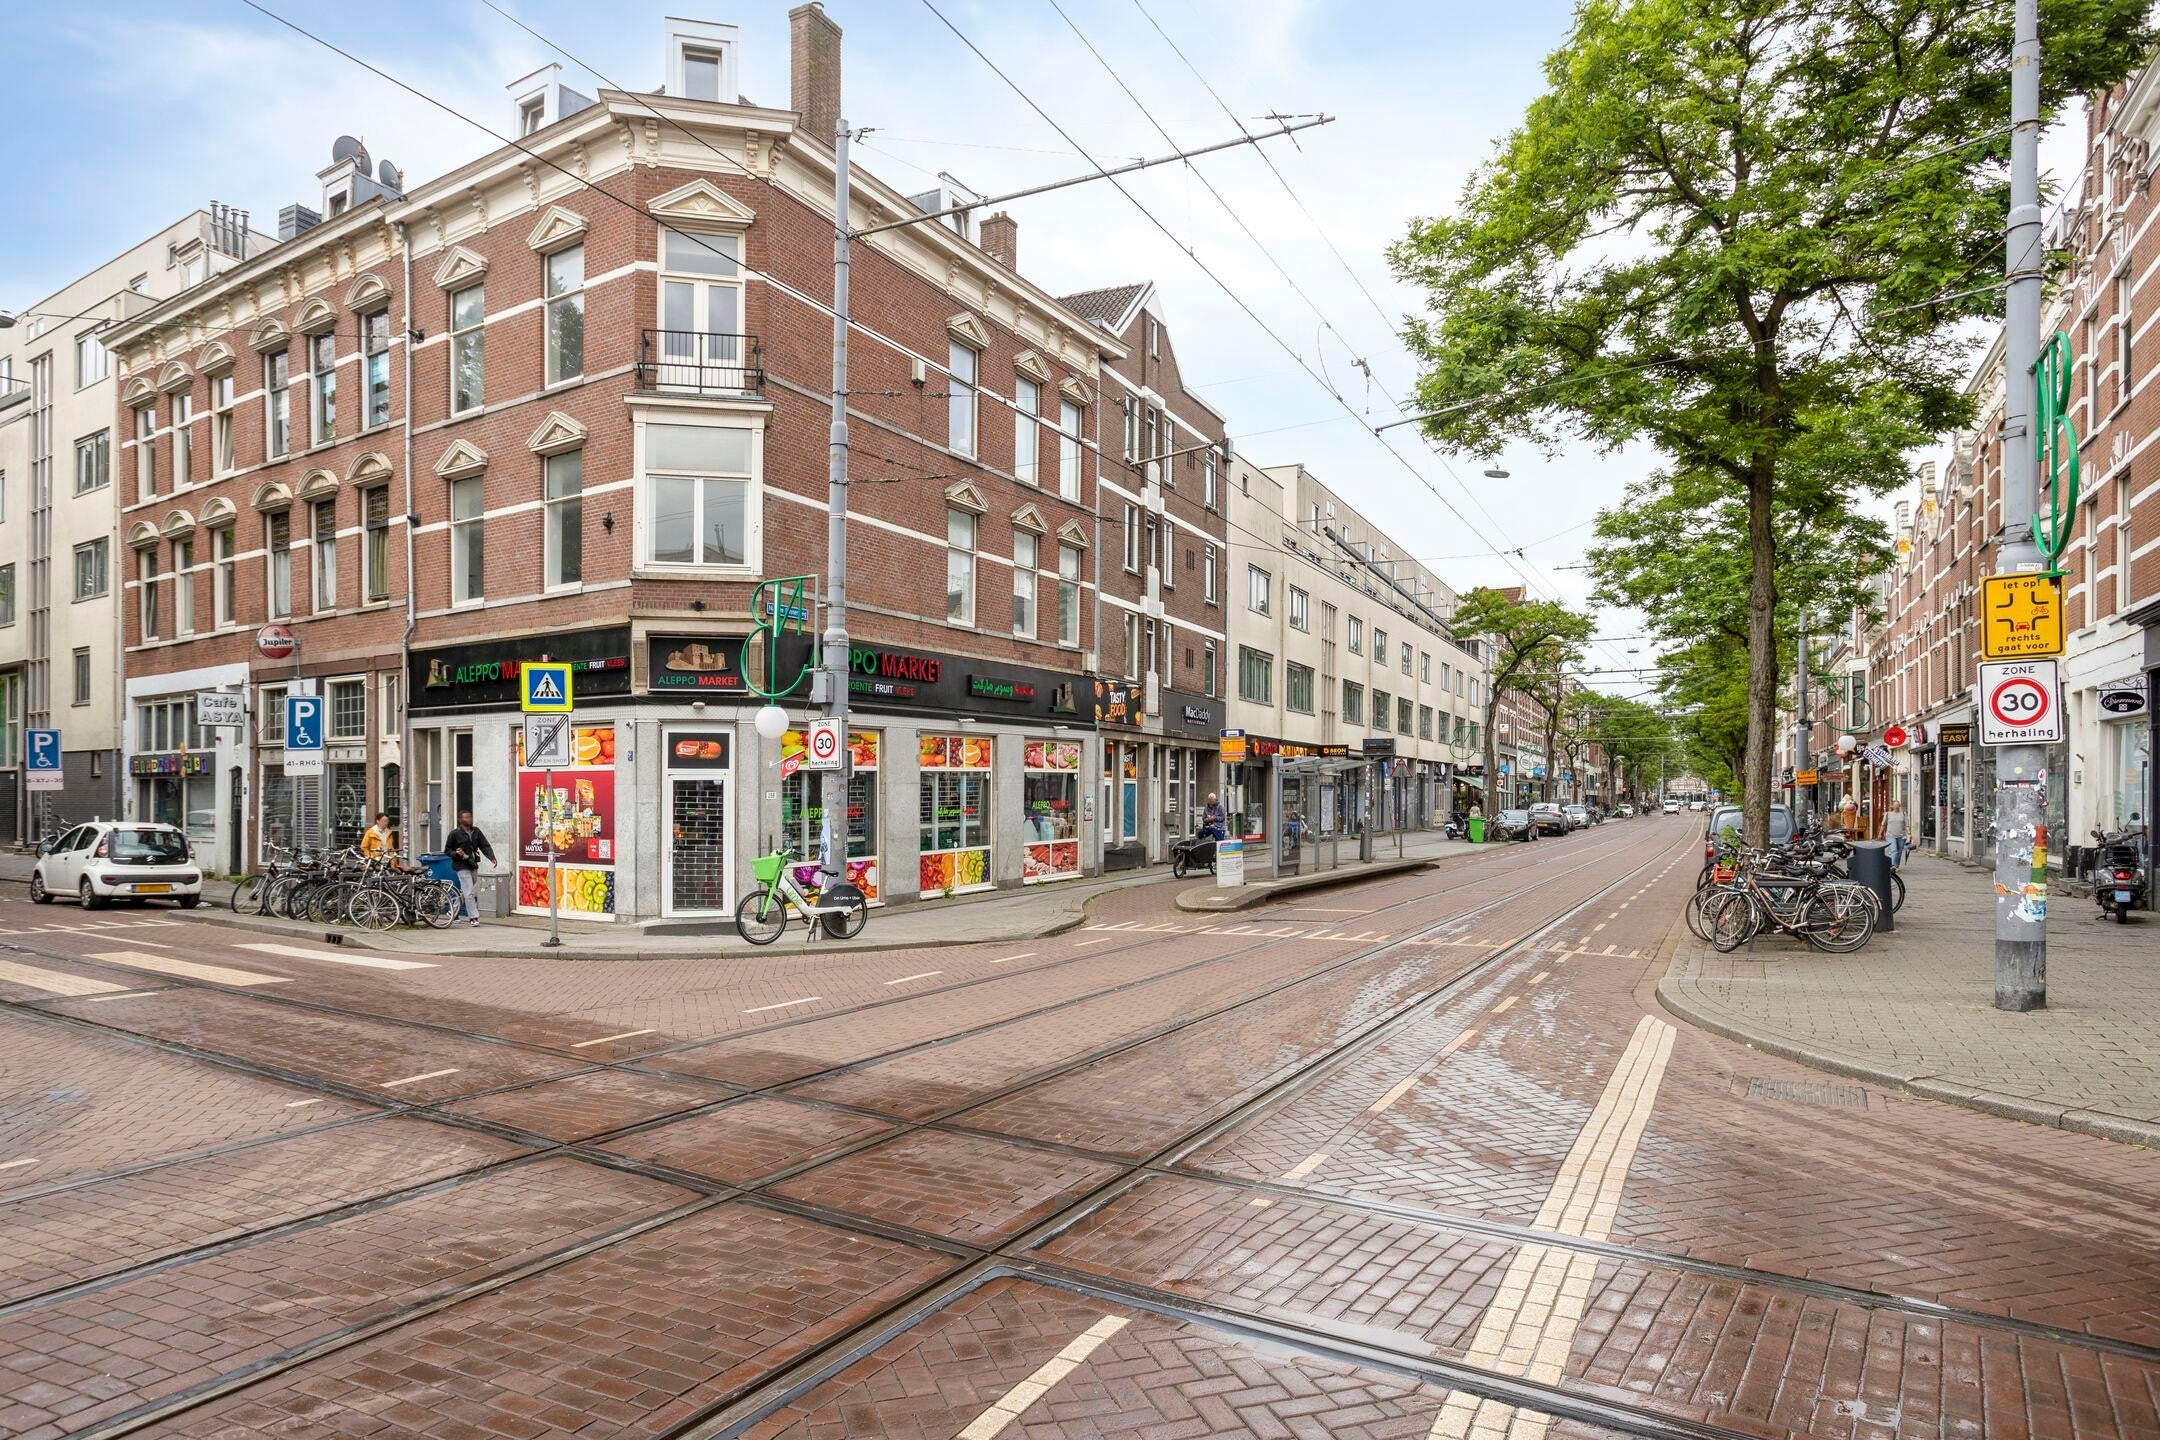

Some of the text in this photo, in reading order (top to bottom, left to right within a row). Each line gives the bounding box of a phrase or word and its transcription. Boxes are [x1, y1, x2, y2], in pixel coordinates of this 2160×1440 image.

[2003, 580, 2041, 590] let op!
[263, 638, 293, 646] Jupiler
[2006, 633, 2041, 642] rechts
[1998, 641, 2050, 654] gaat voor
[589, 660, 605, 670] FRUIT
[881, 651, 943, 683] MARKET
[2002, 665, 2036, 676] ZONE
[455, 661, 500, 685] ALEPPO
[658, 675, 739, 686] ALEPPO MARKET
[875, 683, 894, 695] FRUIT
[1109, 691, 1127, 704] TASTY
[2002, 692, 2039, 712] 30
[295, 701, 315, 727] P
[1110, 703, 1127, 717] FOOD
[200, 711, 243, 723] ASYA
[1942, 734, 1968, 743] EASY
[1988, 727, 2054, 739] herhaling
[34, 733, 54, 753] P
[817, 738, 833, 750] 30
[800, 806, 822, 819] ALEPP
